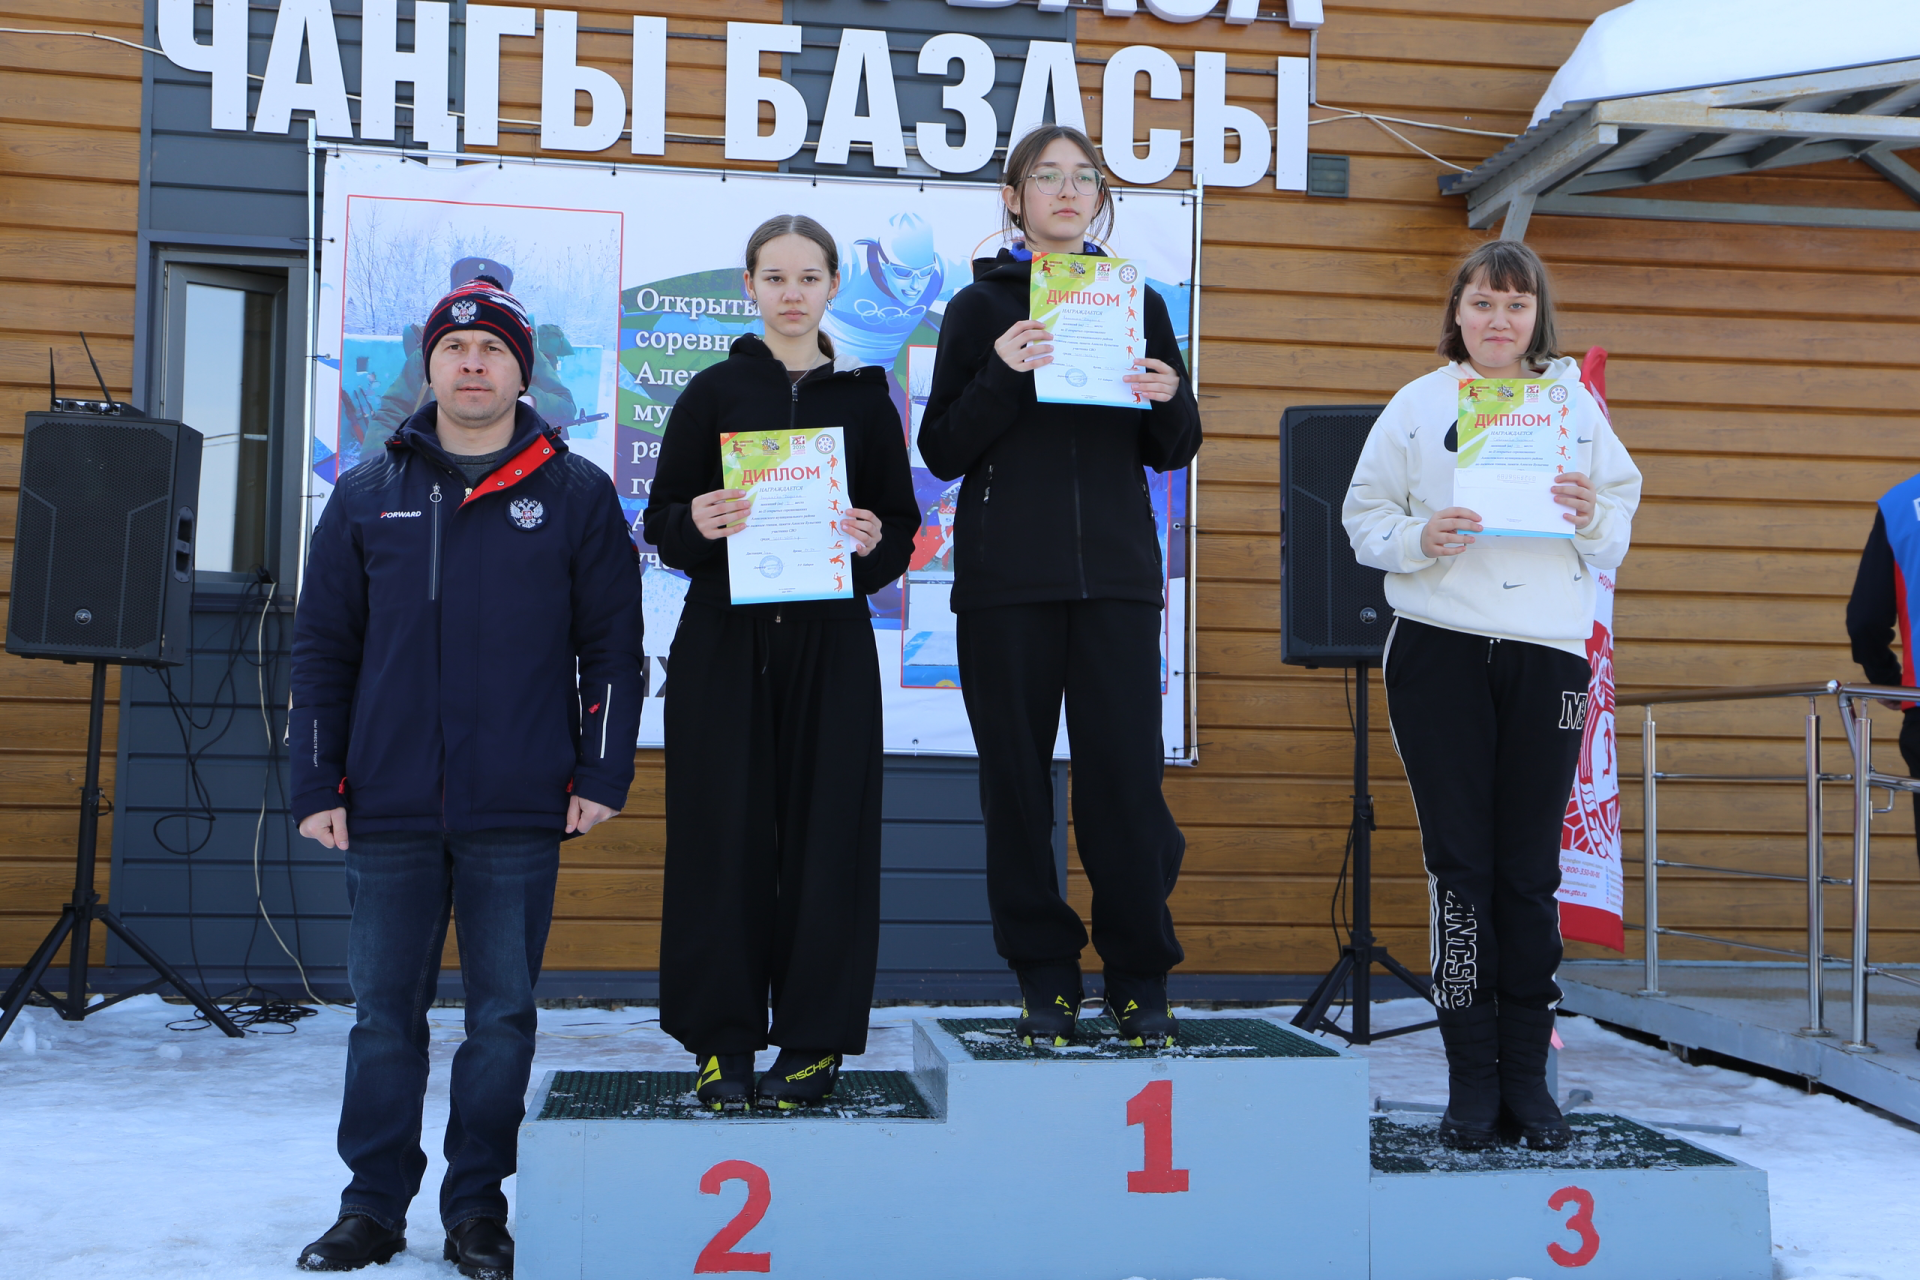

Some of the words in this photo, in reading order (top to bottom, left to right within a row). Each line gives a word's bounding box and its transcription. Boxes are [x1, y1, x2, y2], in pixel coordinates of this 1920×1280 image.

[724, 21, 1309, 191] БАЗАСЫ
[636, 288, 763, 320] Открыты
[1046, 289, 1120, 307] ДИПЛОМ
[635, 330, 746, 356] соревн
[1474, 413, 1551, 429] ДИПЛОМ
[741, 465, 821, 486] ДИПЛОМ
[380, 510, 422, 519] FORWARD
[785, 1054, 835, 1083] FISCHER
[1126, 1080, 1190, 1193] 1
[693, 1160, 772, 1274] 2
[1547, 1185, 1600, 1267] 3
